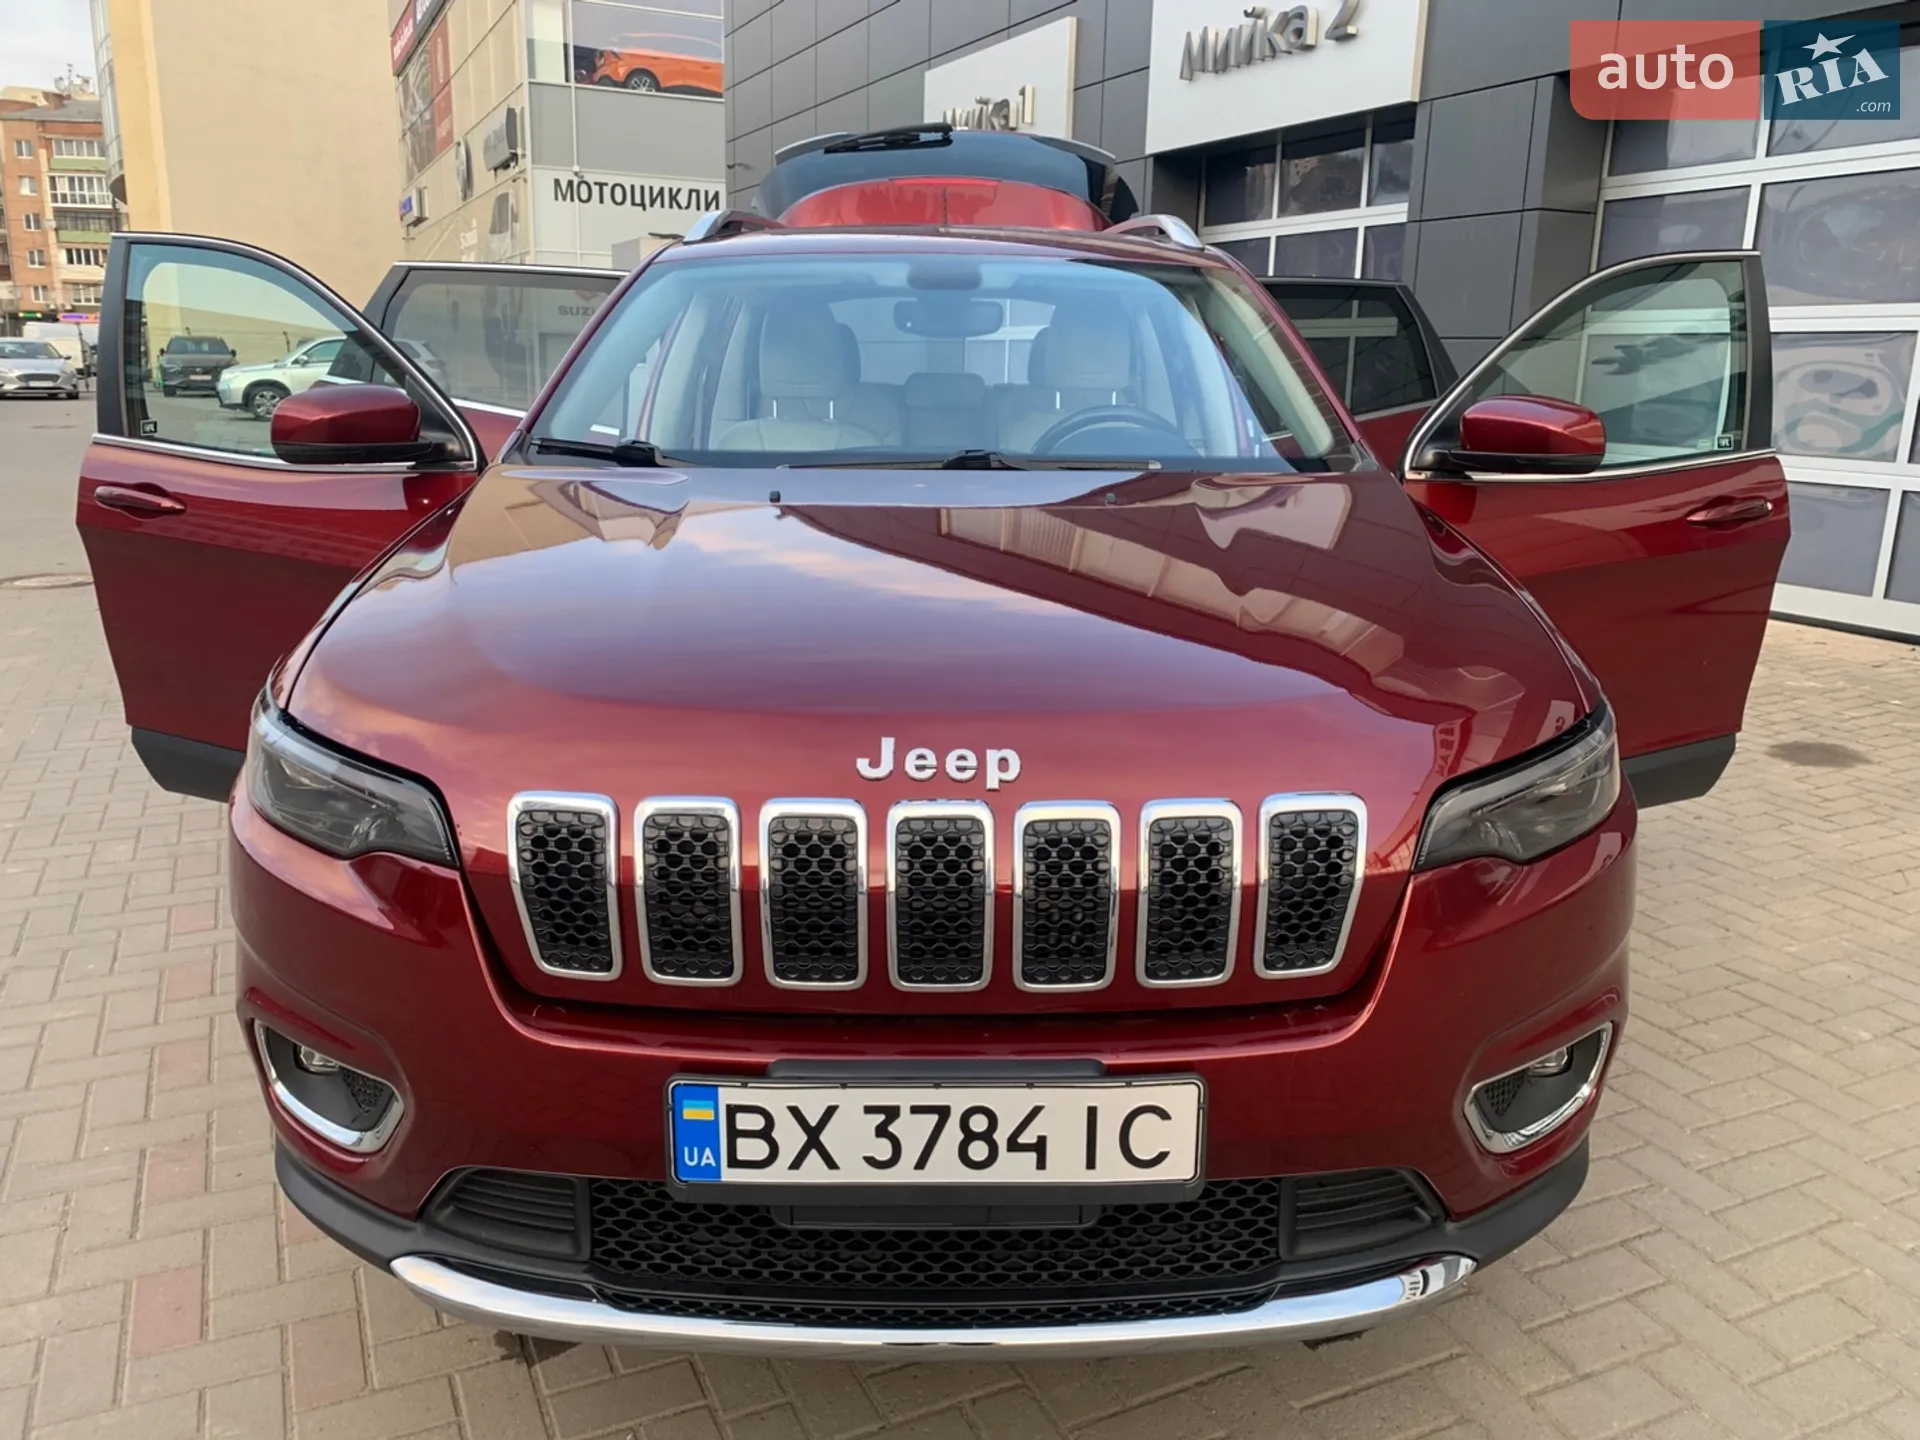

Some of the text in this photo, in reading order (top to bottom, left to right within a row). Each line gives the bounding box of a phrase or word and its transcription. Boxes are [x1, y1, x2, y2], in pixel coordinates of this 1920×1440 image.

[1324, 0, 1358, 41] 2
[1018, 84, 1035, 125] 1
[553, 177, 721, 212] МОТОЦИКЛИ
[856, 736, 1022, 792] Jeep
[683, 1146, 716, 1168] UA
[725, 1104, 1173, 1171] BX 3784 IC
